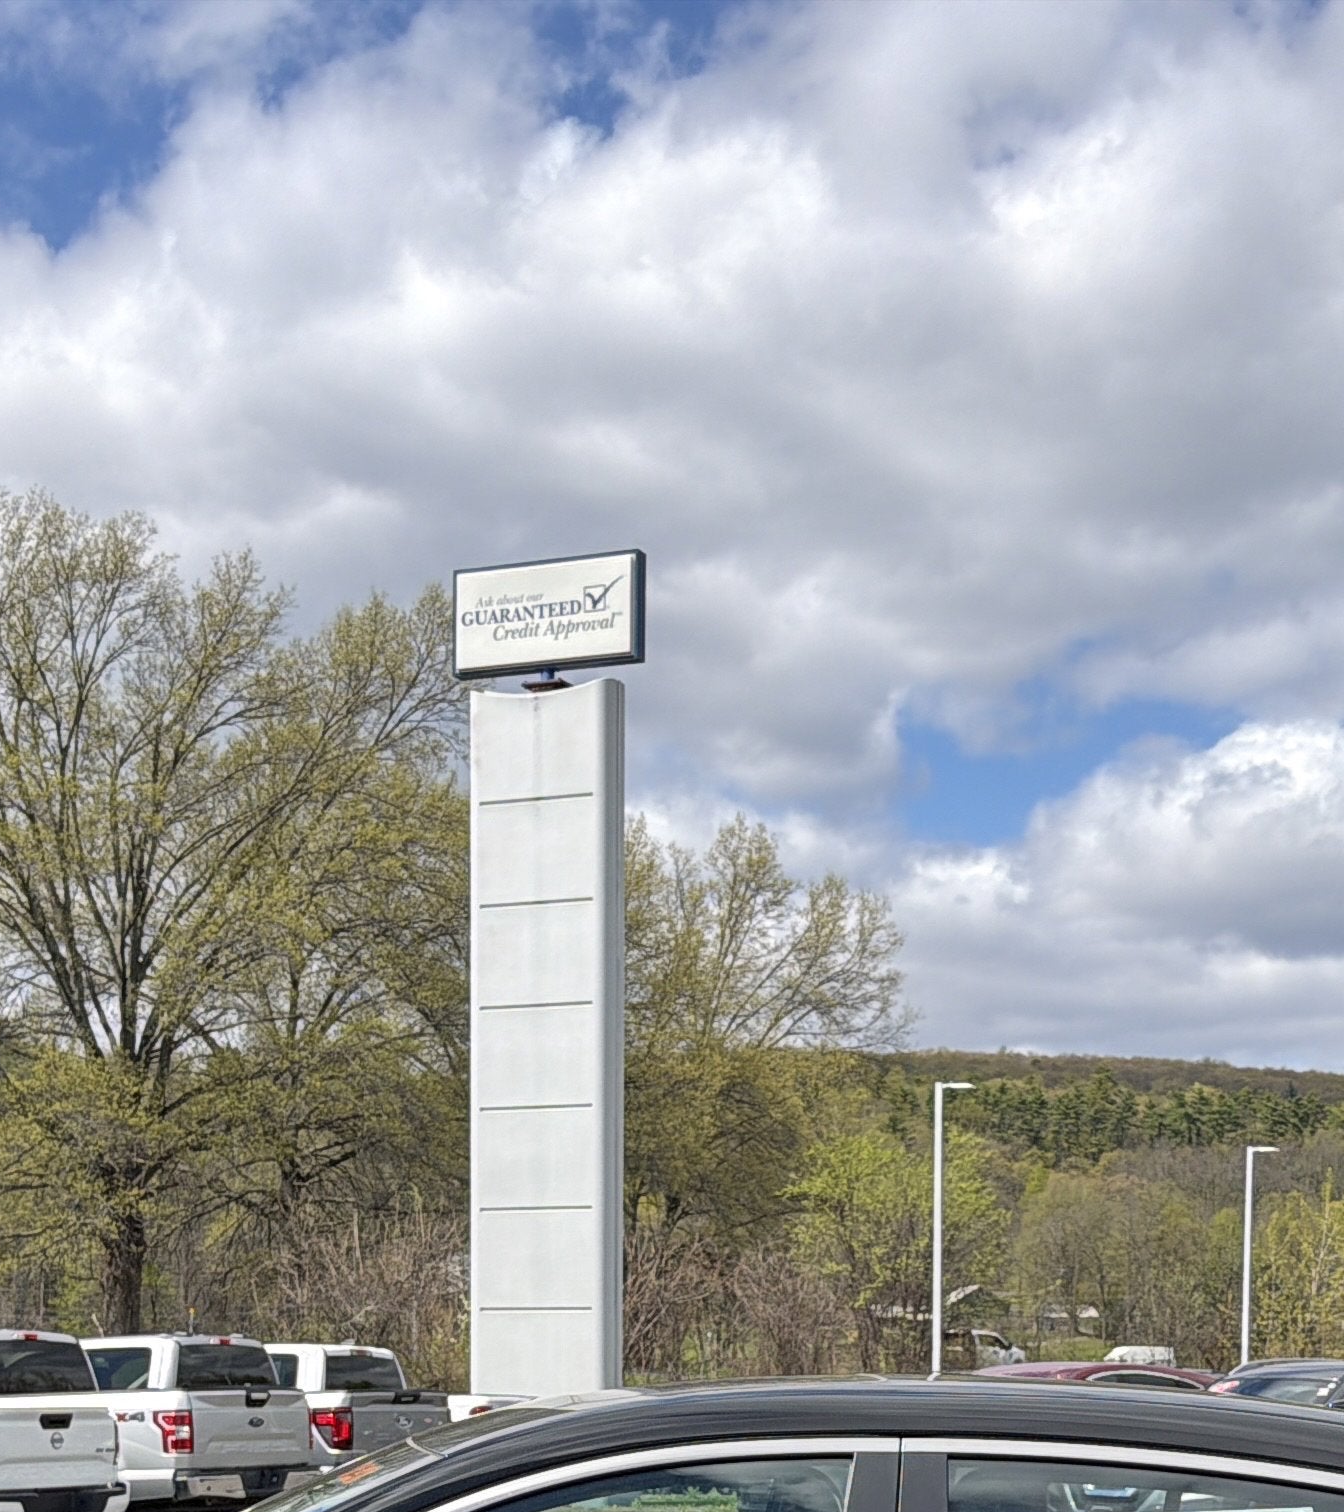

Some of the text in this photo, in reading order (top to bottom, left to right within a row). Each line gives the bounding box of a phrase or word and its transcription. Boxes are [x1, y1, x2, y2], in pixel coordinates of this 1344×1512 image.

[461, 599, 582, 627] GUARANTEED
[475, 592, 545, 609] Ask about our
[493, 612, 616, 642] Credit Approval
